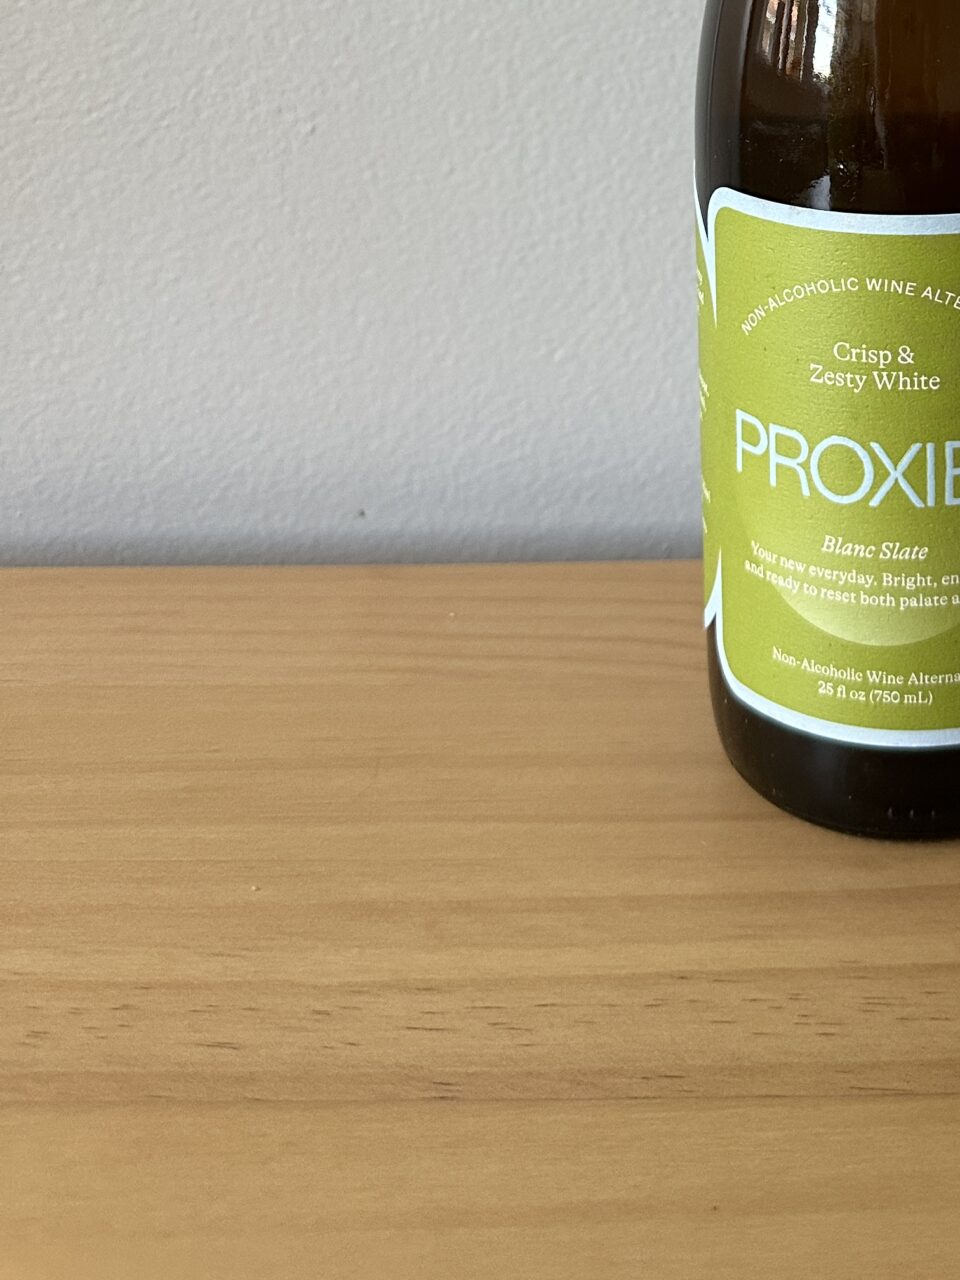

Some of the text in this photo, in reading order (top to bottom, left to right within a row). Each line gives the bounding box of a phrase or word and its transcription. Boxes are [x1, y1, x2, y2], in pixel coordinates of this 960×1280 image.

[741, 277, 859, 336] NON-ALCOHOLIC
[865, 277, 917, 296] WINE
[833, 341, 915, 369] Crisp &
[809, 363, 941, 393] Zesty White
[821, 534, 929, 560] Blanc Slate
[751, 540, 780, 564] Your
[780, 554, 807, 573] new
[808, 564, 878, 588] everyday.
[882, 572, 938, 590] Bright,
[744, 559, 765, 578] and
[766, 570, 801, 593] ready
[802, 581, 818, 596] to
[820, 587, 857, 604] reset
[859, 590, 896, 607] both
[899, 593, 948, 611] palate
[772, 646, 863, 682] Non-Alcoholic
[866, 670, 904, 685] Wine
[817, 680, 933, 706] 25 fl oz (750 mL)
